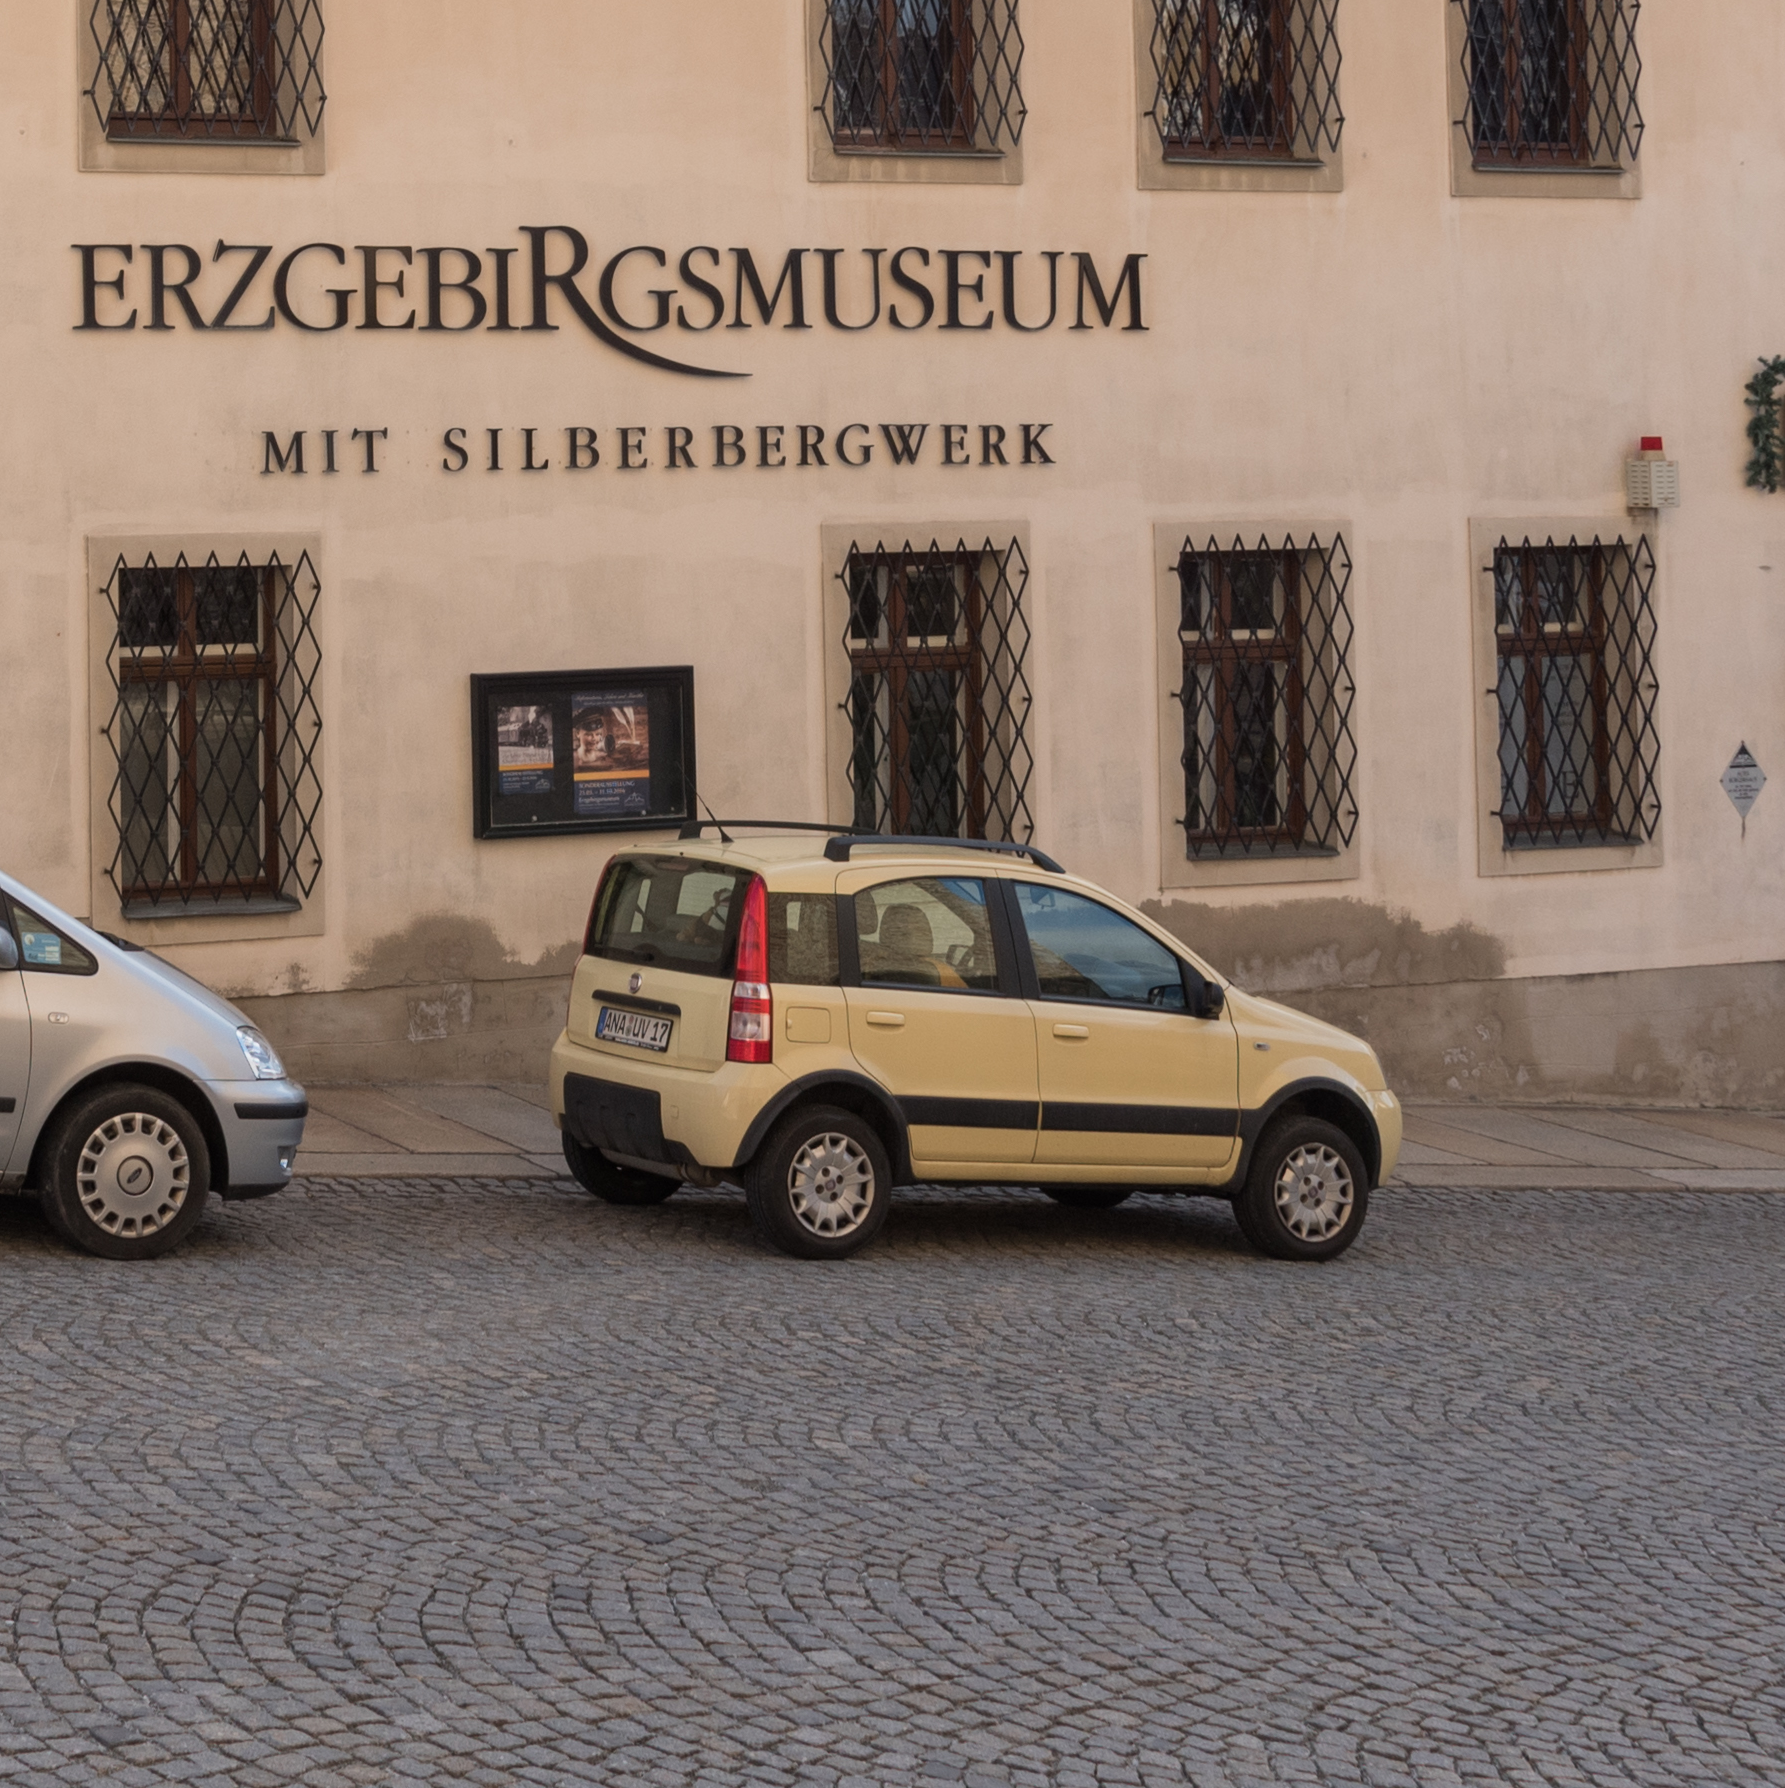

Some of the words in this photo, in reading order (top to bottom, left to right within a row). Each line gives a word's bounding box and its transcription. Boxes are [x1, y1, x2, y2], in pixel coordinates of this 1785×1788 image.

[70, 225, 1150, 379] ERZGEBIRGSMUSEUM
[260, 427, 388, 475] MIT
[442, 423, 1056, 472] SILBERBERGWERK
[603, 1012, 626, 1035] ANA
[632, 1016, 651, 1039] UV
[650, 1021, 669, 1043] 17
